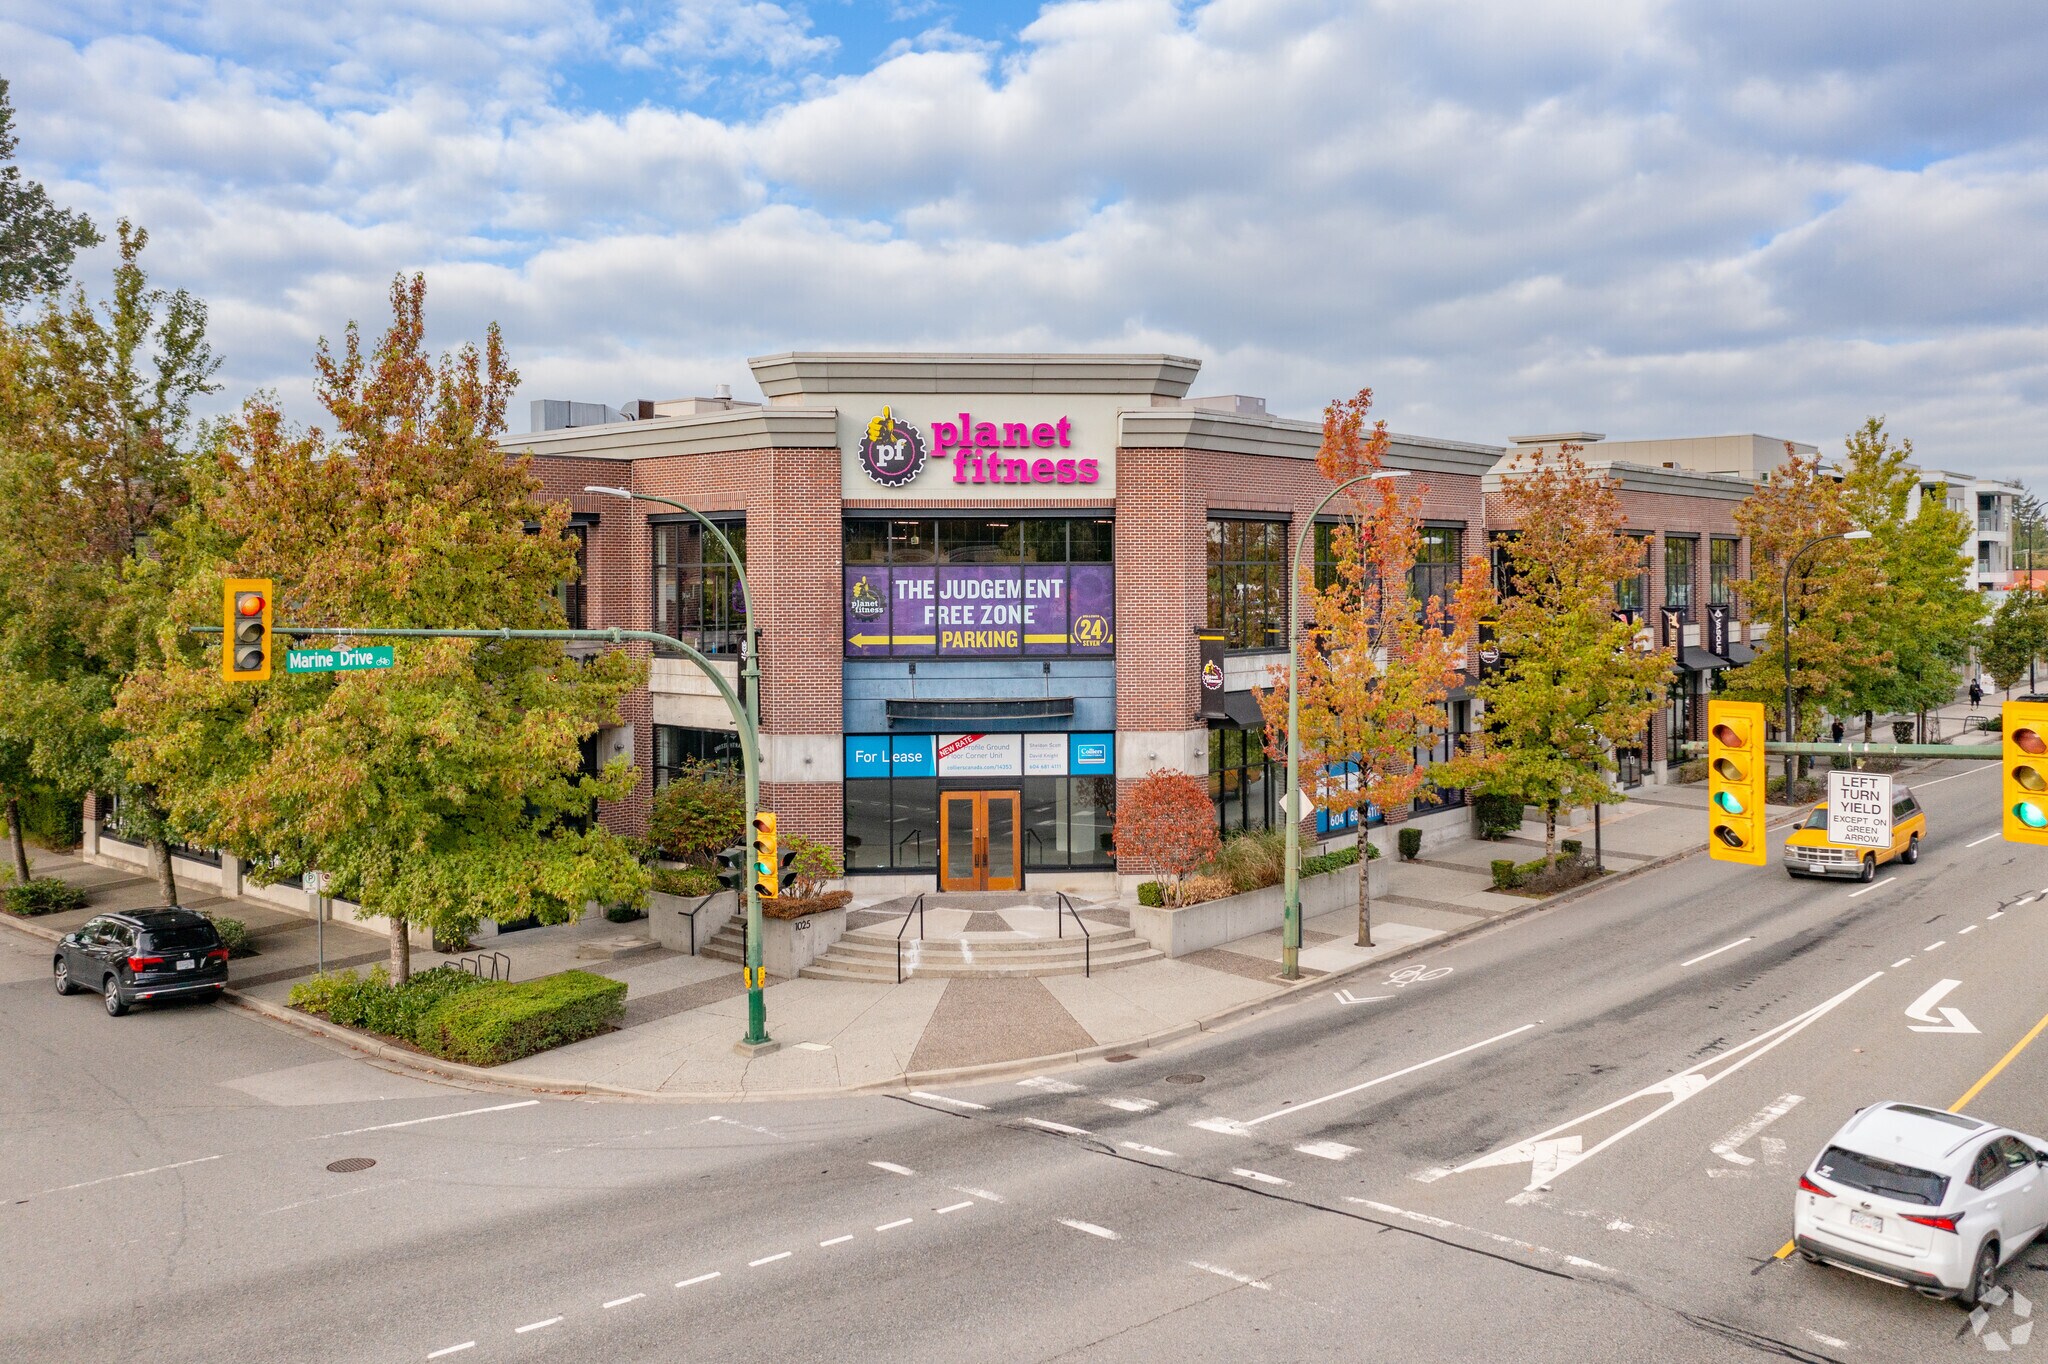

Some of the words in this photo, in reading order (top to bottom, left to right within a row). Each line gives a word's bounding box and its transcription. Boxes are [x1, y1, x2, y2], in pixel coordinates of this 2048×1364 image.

[931, 413, 1071, 457] planet
[876, 438, 907, 466] pf
[953, 448, 1099, 483] fitness
[895, 580, 934, 599] THE
[940, 579, 1063, 599] JUDGEMENT
[851, 600, 878, 608] planet
[855, 605, 883, 613] fitness
[924, 605, 973, 625] FREE
[980, 604, 1035, 624] ZONE
[1080, 619, 1102, 639] 24
[942, 630, 1018, 648] PARKING
[289, 652, 333, 668] Marine
[340, 650, 373, 666] Drive
[939, 743, 955, 757] NEW
[955, 735, 973, 749] RATE
[855, 750, 877, 763] For
[882, 750, 922, 763] Lease
[1842, 776, 1878, 788] LEFT
[1841, 789, 1879, 801] TURN
[1841, 802, 1881, 815] YIELD
[1331, 814, 1344, 826] 604
[1350, 810, 1358, 822] 68
[1833, 815, 1868, 824] EXCEPT
[1846, 825, 1877, 834] GREEN
[1844, 834, 1879, 843] ARROW
[795, 919, 811, 931] 1025
